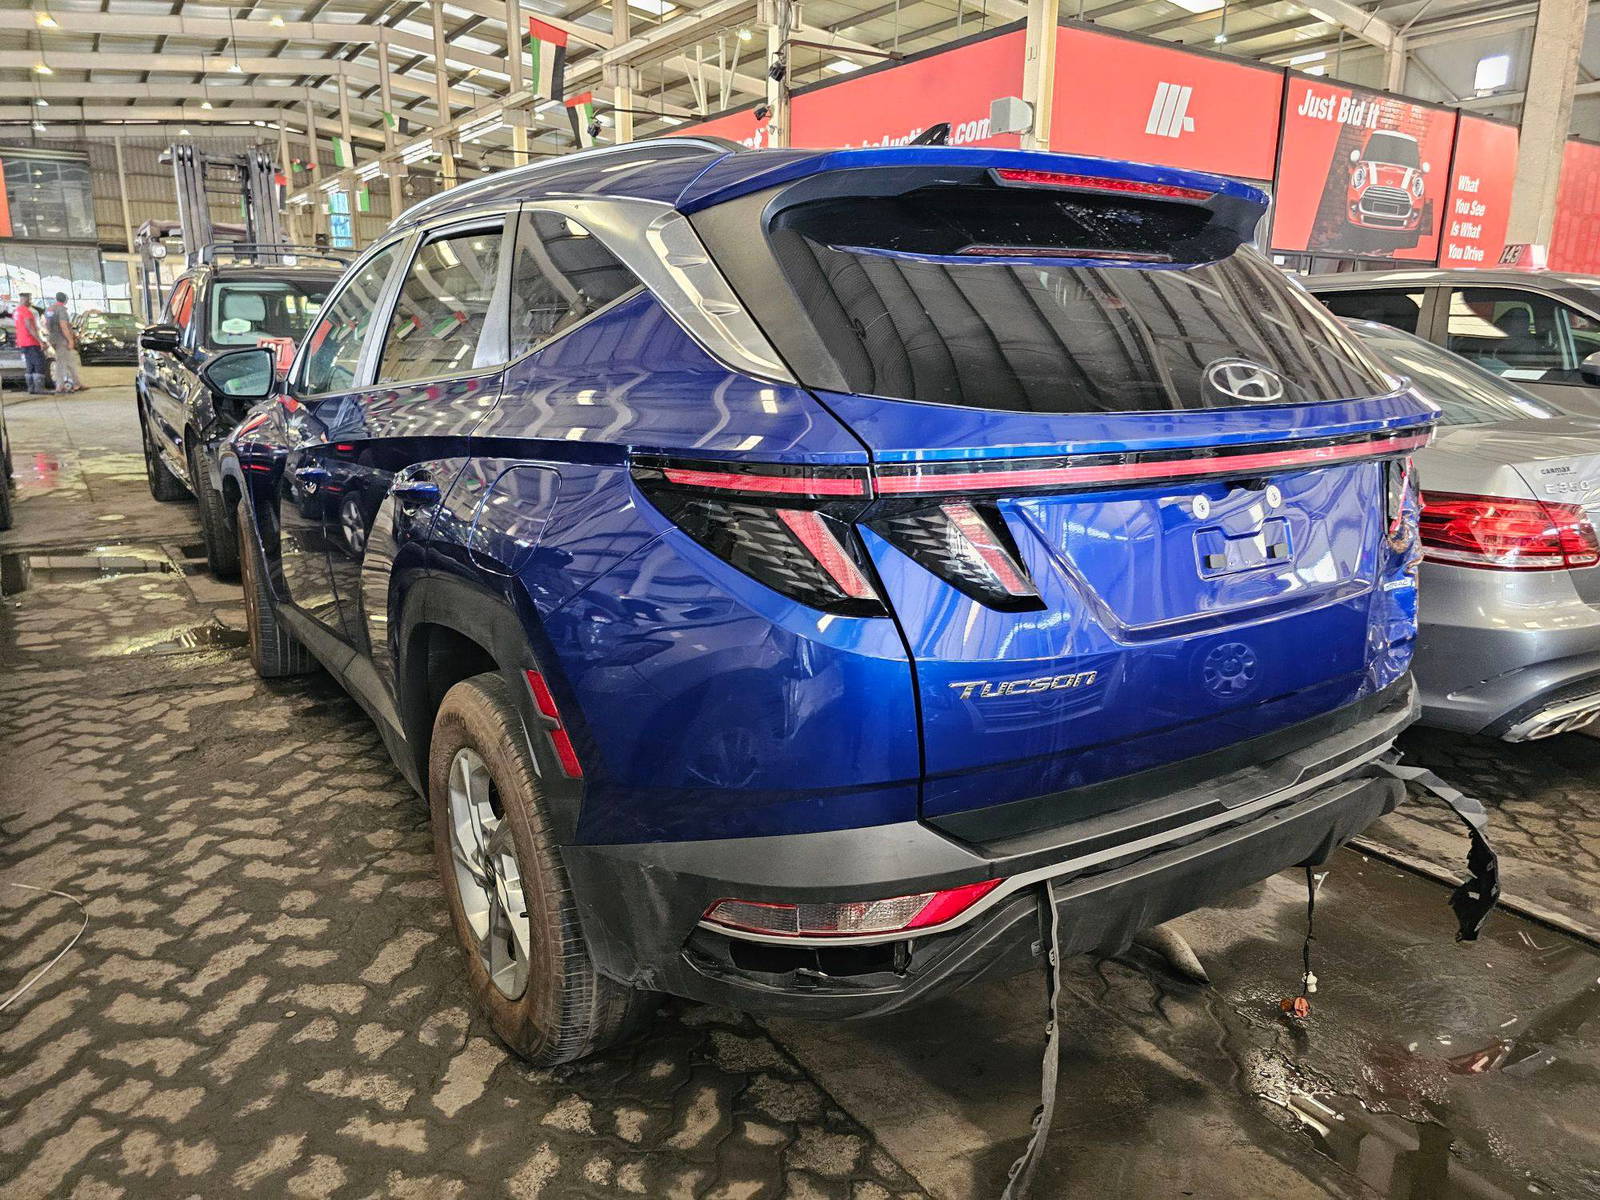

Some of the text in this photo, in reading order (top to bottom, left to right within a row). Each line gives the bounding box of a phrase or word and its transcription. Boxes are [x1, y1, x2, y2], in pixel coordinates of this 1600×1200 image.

[1298, 89, 1380, 129] Just Bid It
[1458, 175, 1480, 193] What
[1455, 198, 1486, 217] You See
[1450, 221, 1482, 239] Is What
[1448, 243, 1484, 262] You Drive
